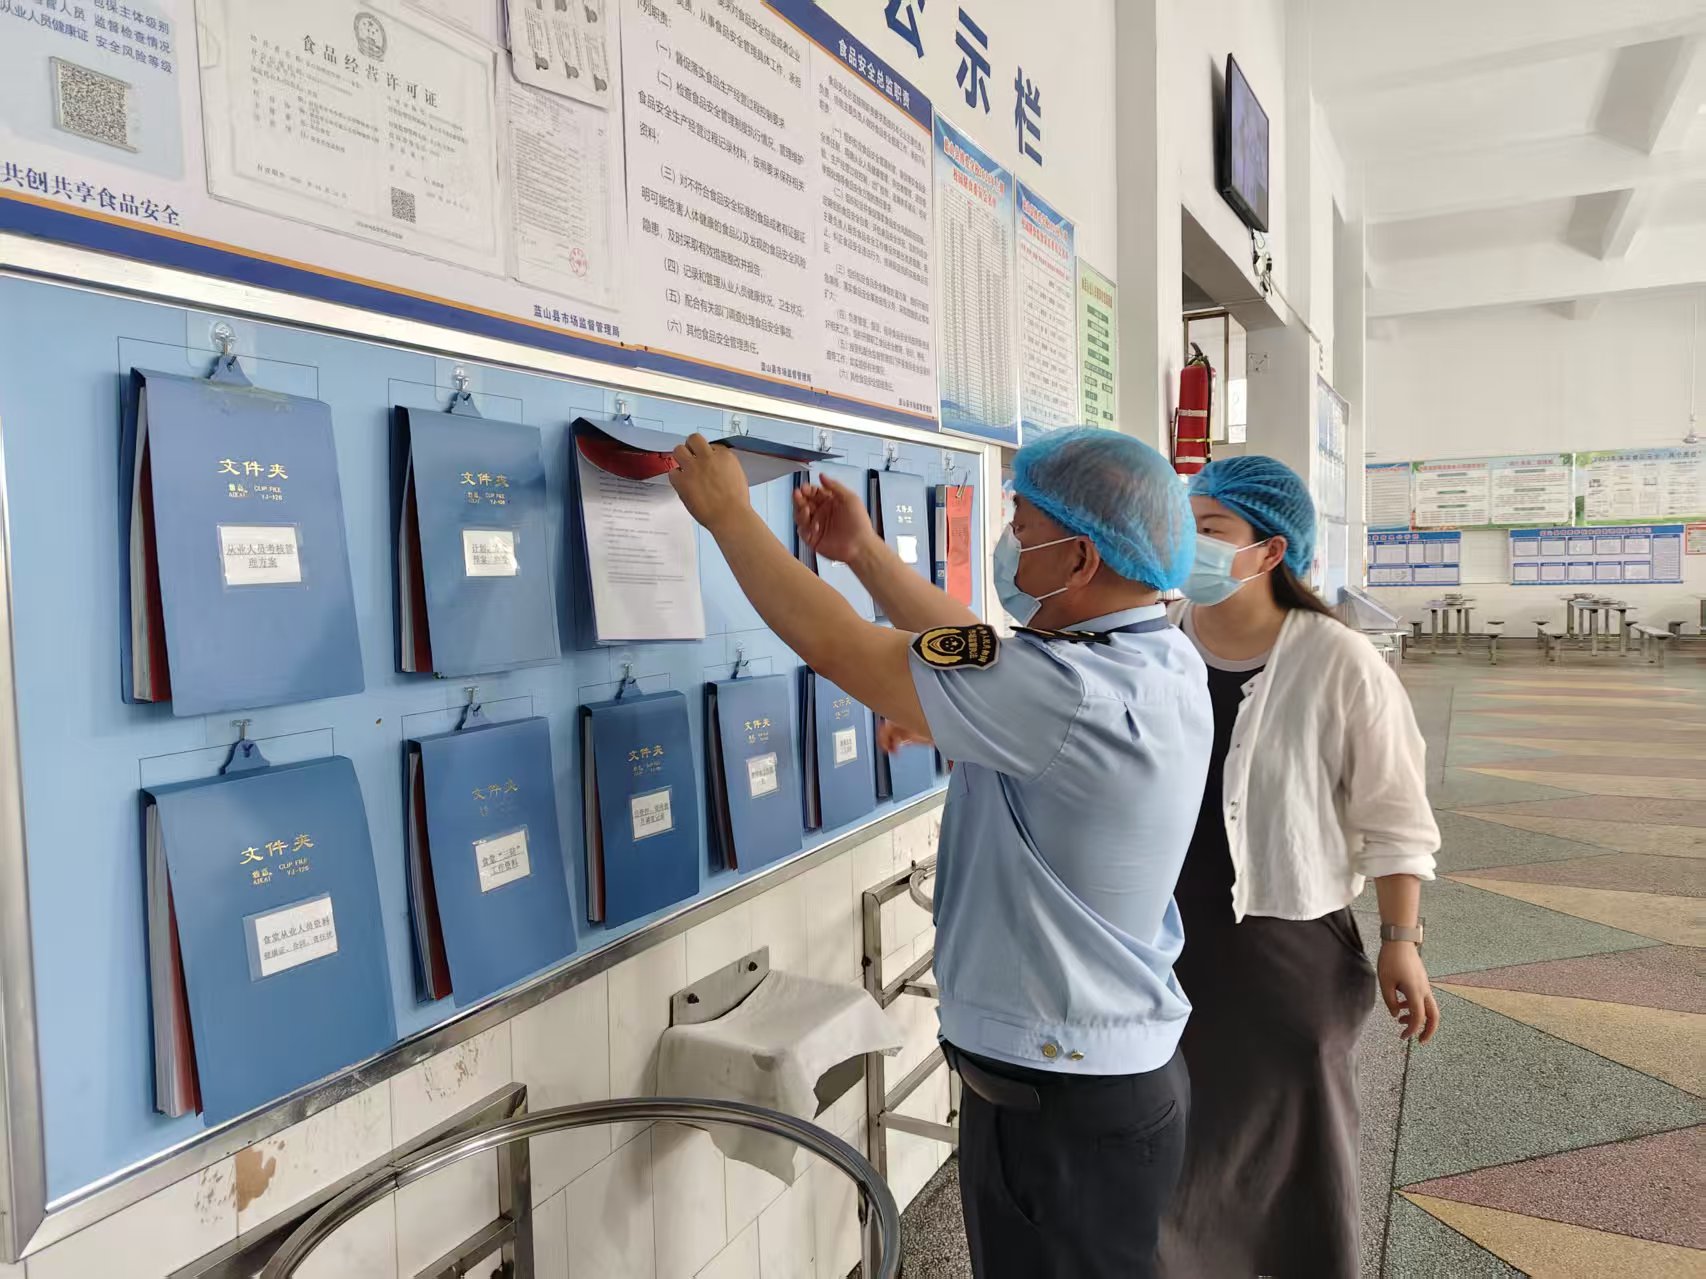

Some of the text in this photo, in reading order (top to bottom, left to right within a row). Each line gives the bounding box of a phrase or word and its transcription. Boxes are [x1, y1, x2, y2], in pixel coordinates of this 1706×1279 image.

[94, 14, 172, 54] 监督检查情况
[95, 35, 173, 74] 安全风险等级
[303, 34, 439, 109] 食品经营许可证
[838, 38, 910, 110] 食品安全总监职责
[0, 161, 181, 226] 共创共享食品安全
[533, 304, 620, 337] 蓝山县市场监督管理局
[217, 458, 288, 480] 文件夹
[460, 472, 510, 488] 文件夹
[744, 718, 771, 731] 文件夹
[628, 744, 665, 762] 文件夹
[471, 779, 519, 801] 文件夹
[239, 832, 315, 865] 文件夹
